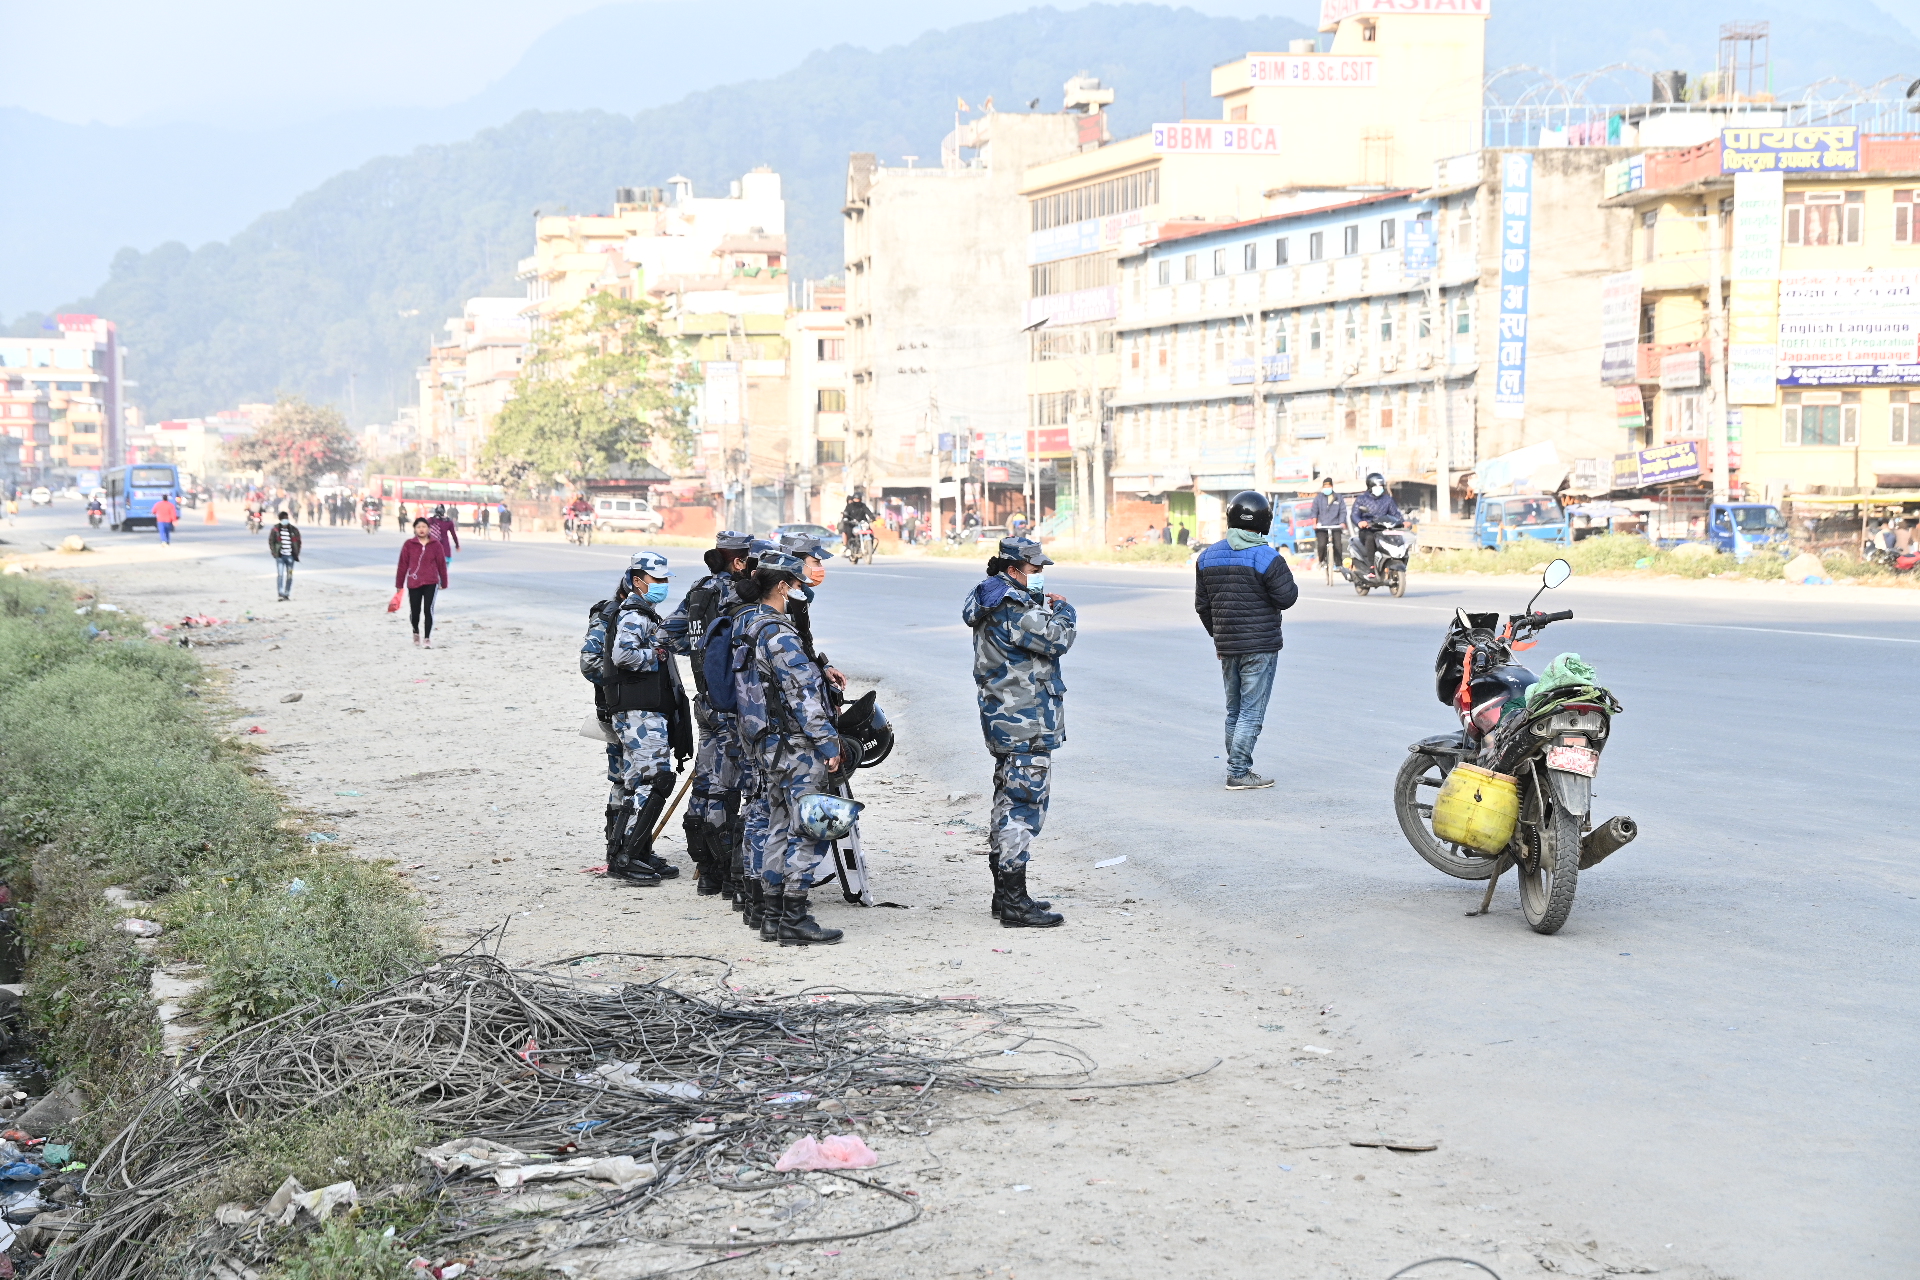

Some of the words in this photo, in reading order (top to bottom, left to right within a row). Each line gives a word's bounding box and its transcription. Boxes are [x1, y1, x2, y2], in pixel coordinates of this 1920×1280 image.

[1259, 61, 1286, 81] BIM
[1302, 61, 1373, 81] B.Sc.CSIT
[1167, 127, 1213, 150] BBM
[1237, 127, 1278, 150] BCA
[1780, 323, 1834, 335] English
[1839, 323, 1910, 334] Language
[1851, 337, 1915, 348] Preparation
[1780, 351, 1843, 363] Japanese
[1847, 350, 1912, 362] Language
